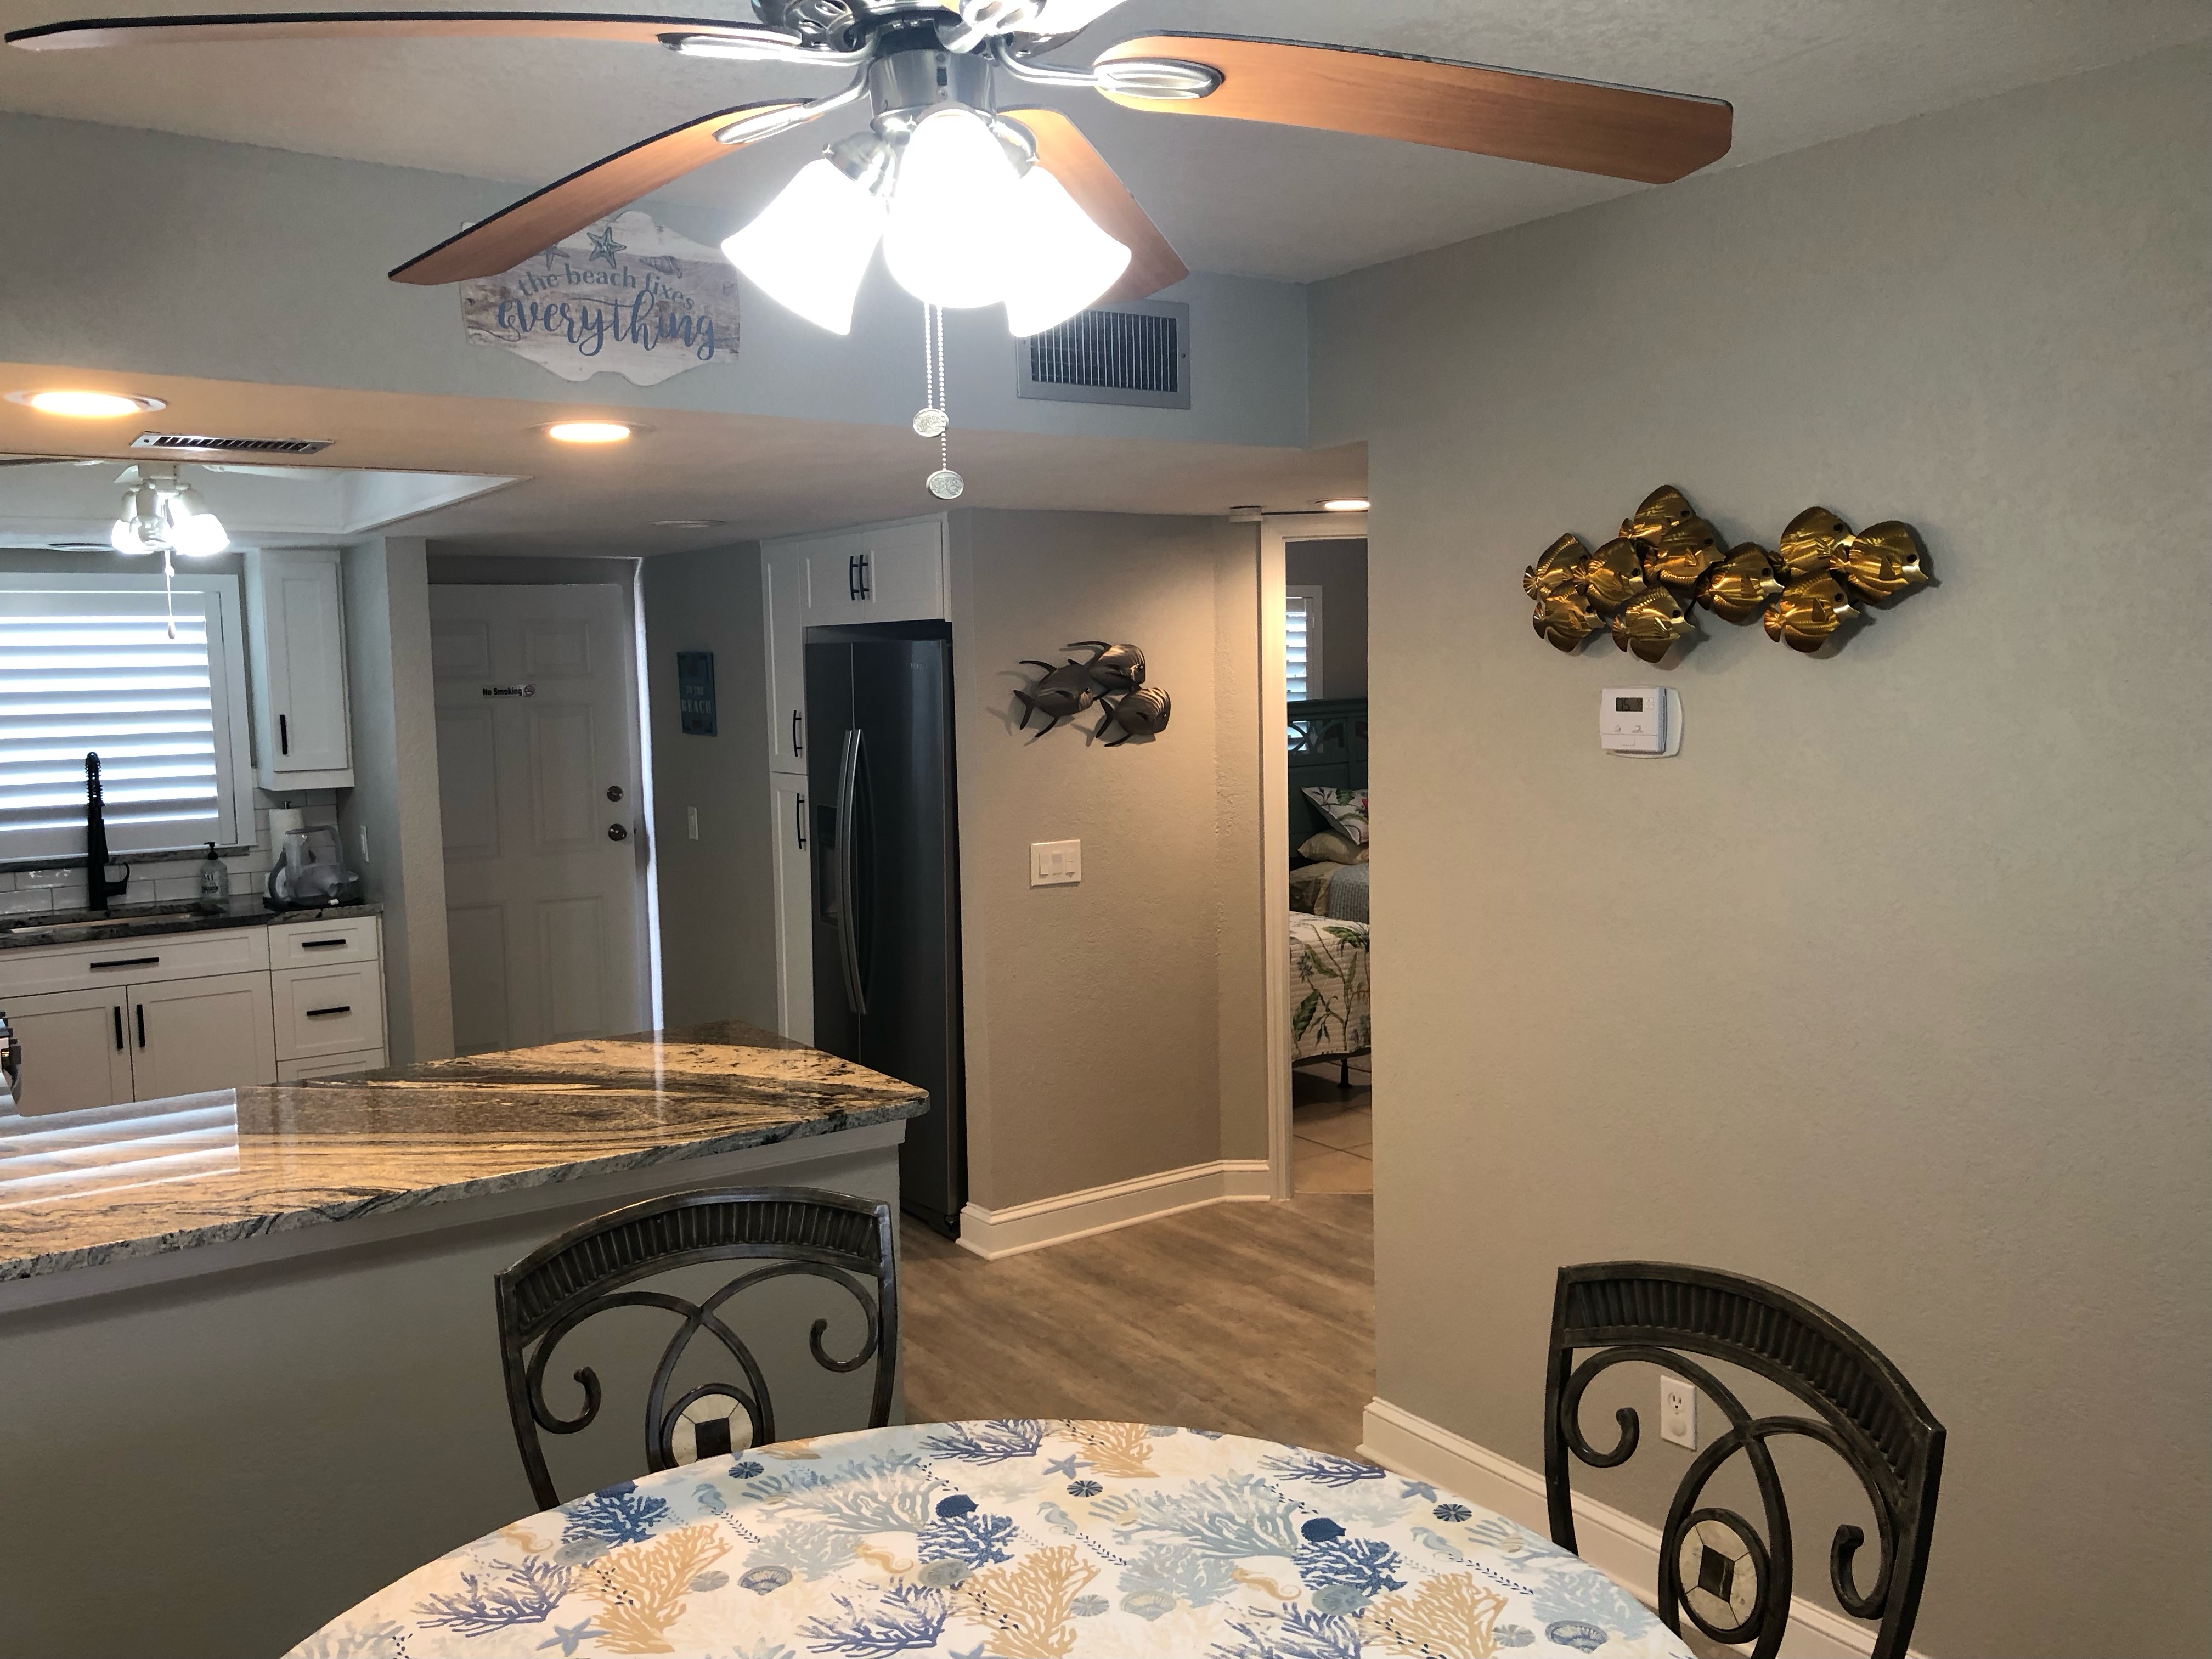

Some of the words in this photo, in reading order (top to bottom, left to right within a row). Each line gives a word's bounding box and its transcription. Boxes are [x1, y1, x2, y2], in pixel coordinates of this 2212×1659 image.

[518, 270, 560, 297] the
[565, 263, 636, 289] beach
[644, 272, 695, 311] fixes
[497, 290, 715, 361] everything
[494, 687, 522, 696] Smoking
[682, 699, 711, 714] BEACH
